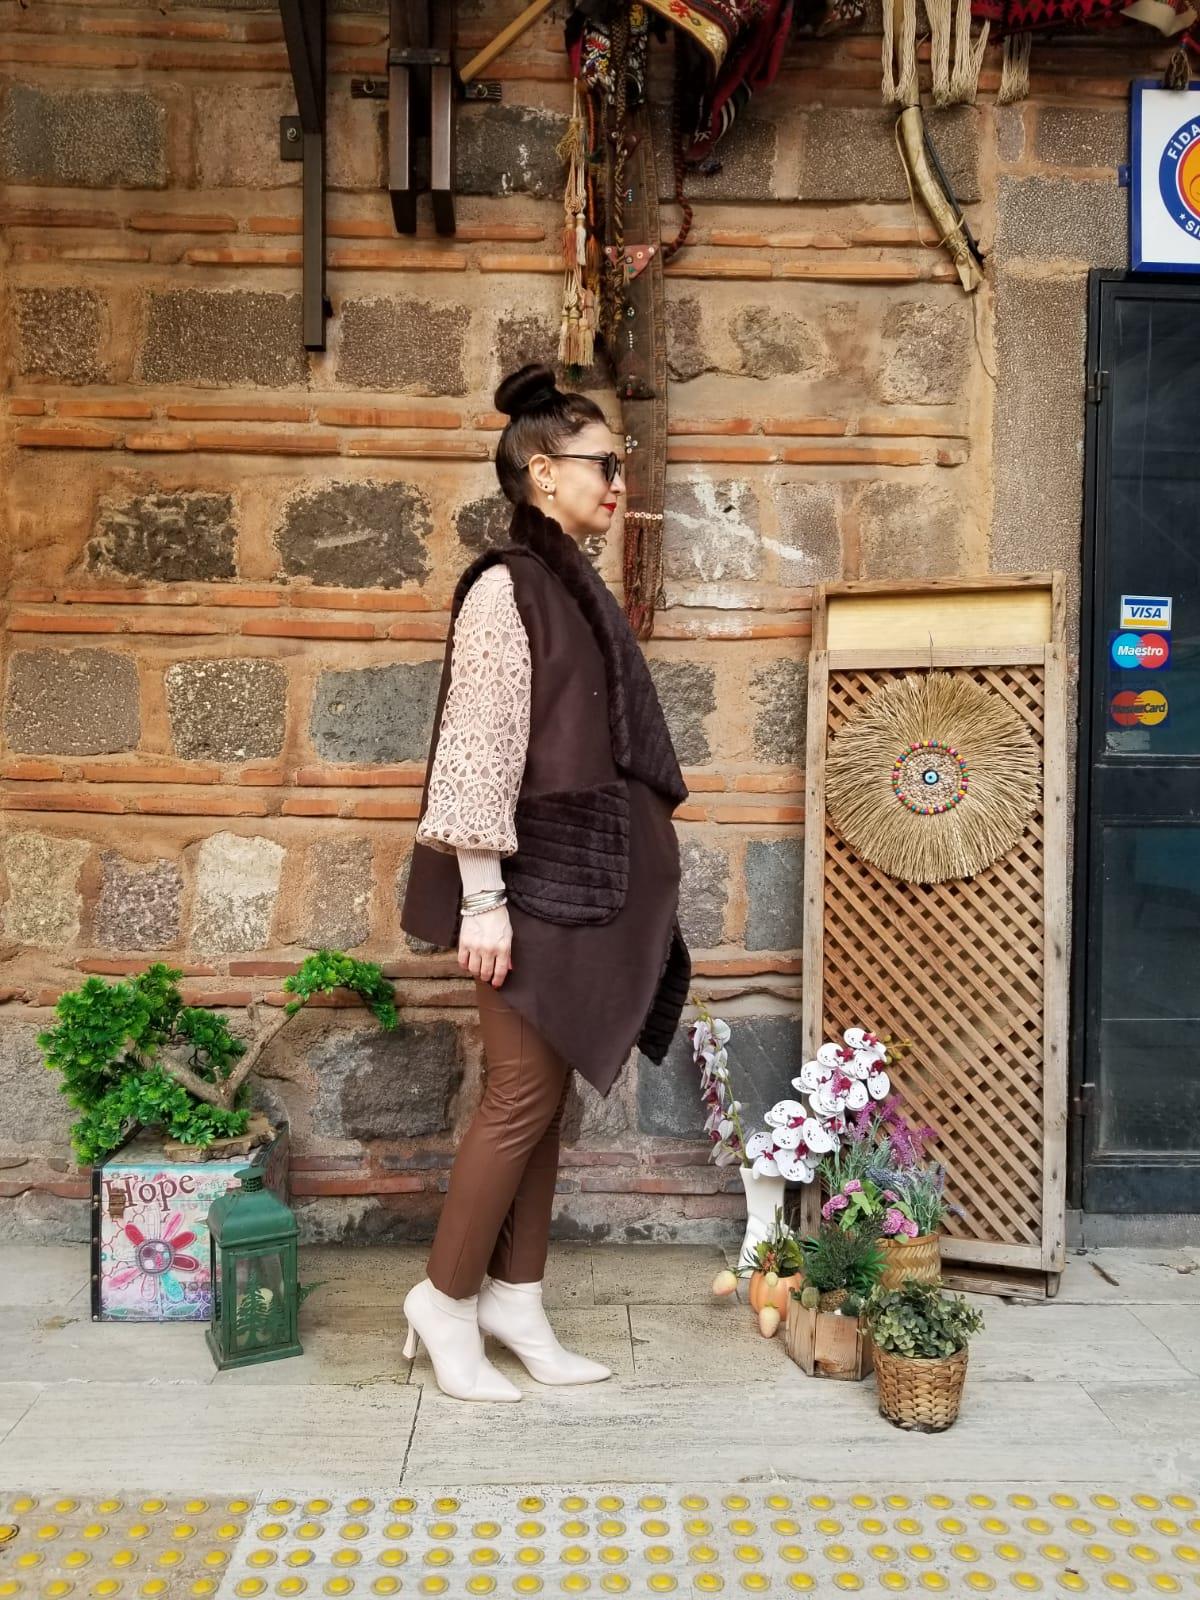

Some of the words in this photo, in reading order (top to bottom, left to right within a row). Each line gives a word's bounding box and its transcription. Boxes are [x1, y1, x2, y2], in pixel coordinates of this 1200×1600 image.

[1130, 606, 1162, 619] VISA
[1117, 645, 1164, 656] Maestro
[102, 1174, 196, 1212] Hope
